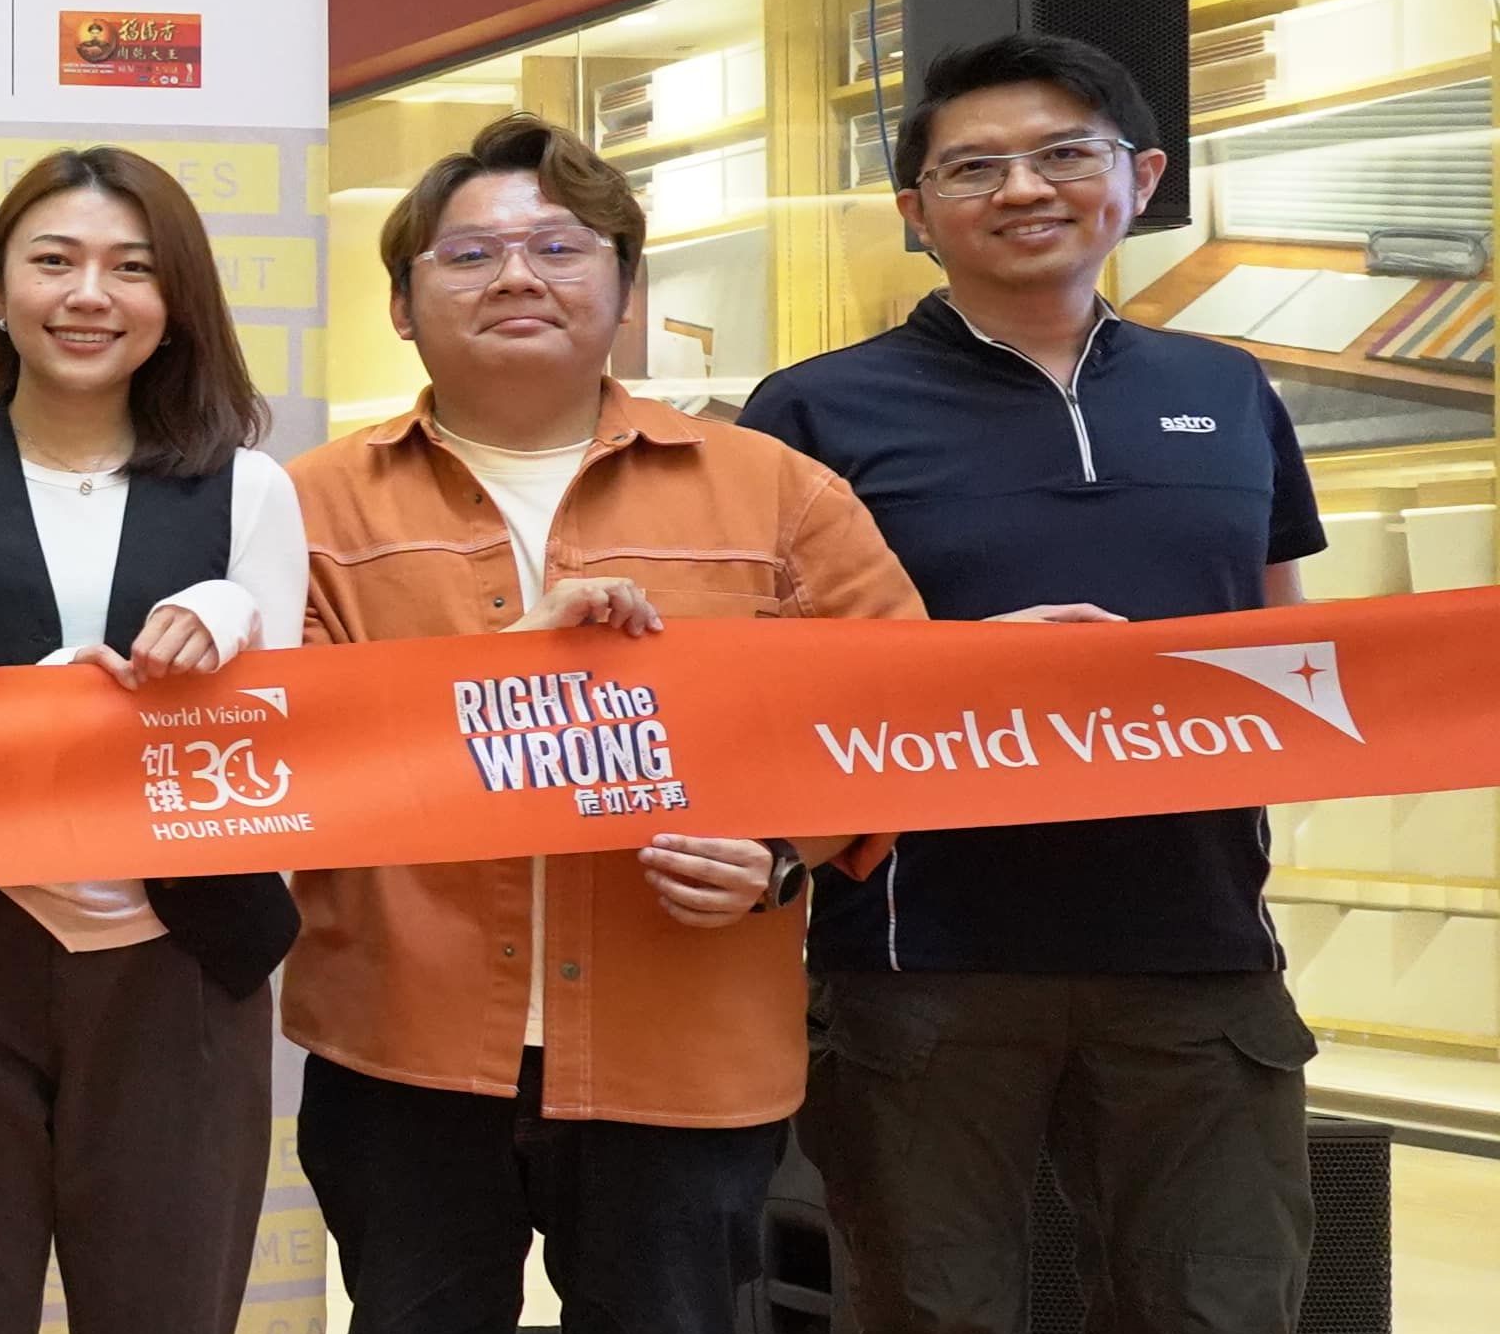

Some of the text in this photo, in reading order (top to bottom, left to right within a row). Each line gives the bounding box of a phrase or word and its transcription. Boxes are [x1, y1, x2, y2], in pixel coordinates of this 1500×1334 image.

[1160, 414, 1216, 432] astro
[140, 706, 266, 727] World Vision
[453, 670, 656, 734] RIGHT the
[465, 719, 673, 792] WRONG
[815, 705, 1283, 773] World Vision
[153, 814, 313, 839] HOUR FAMINE
